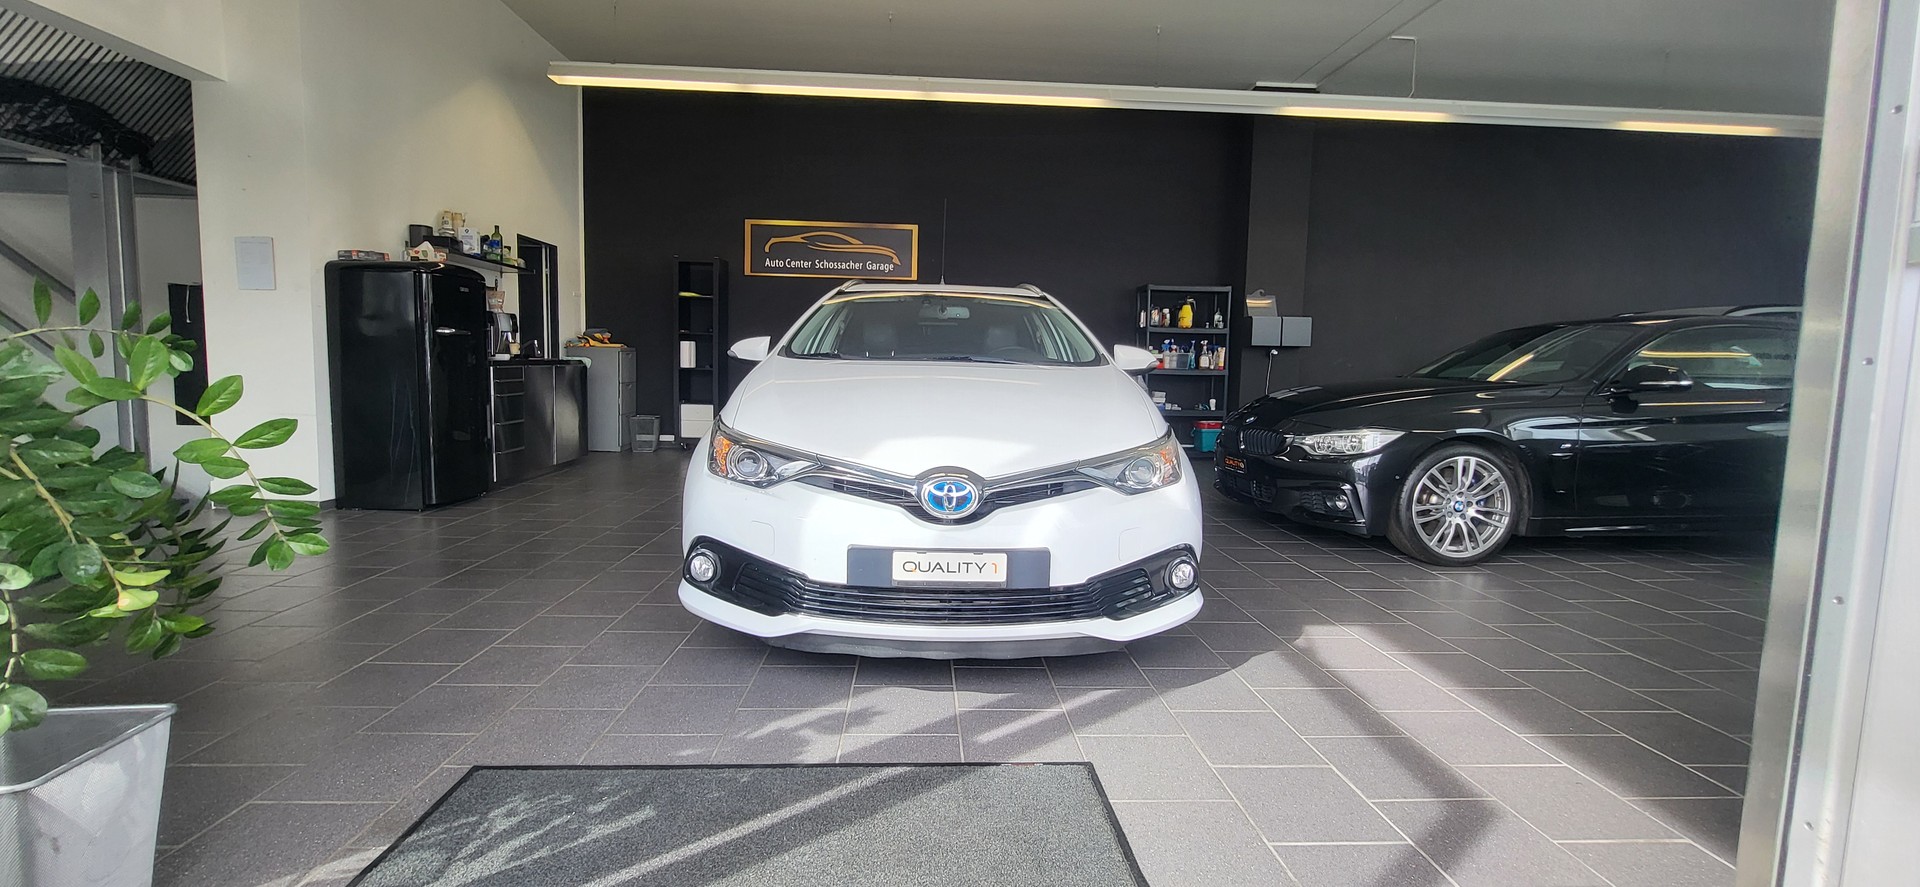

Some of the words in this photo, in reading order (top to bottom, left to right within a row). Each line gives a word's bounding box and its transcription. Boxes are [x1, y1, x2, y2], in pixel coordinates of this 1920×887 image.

[765, 258, 784, 268] Auto
[786, 258, 812, 269] Center
[815, 260, 863, 270] Schossacher
[866, 261, 894, 272] Garage
[902, 561, 987, 574] QUALITY
